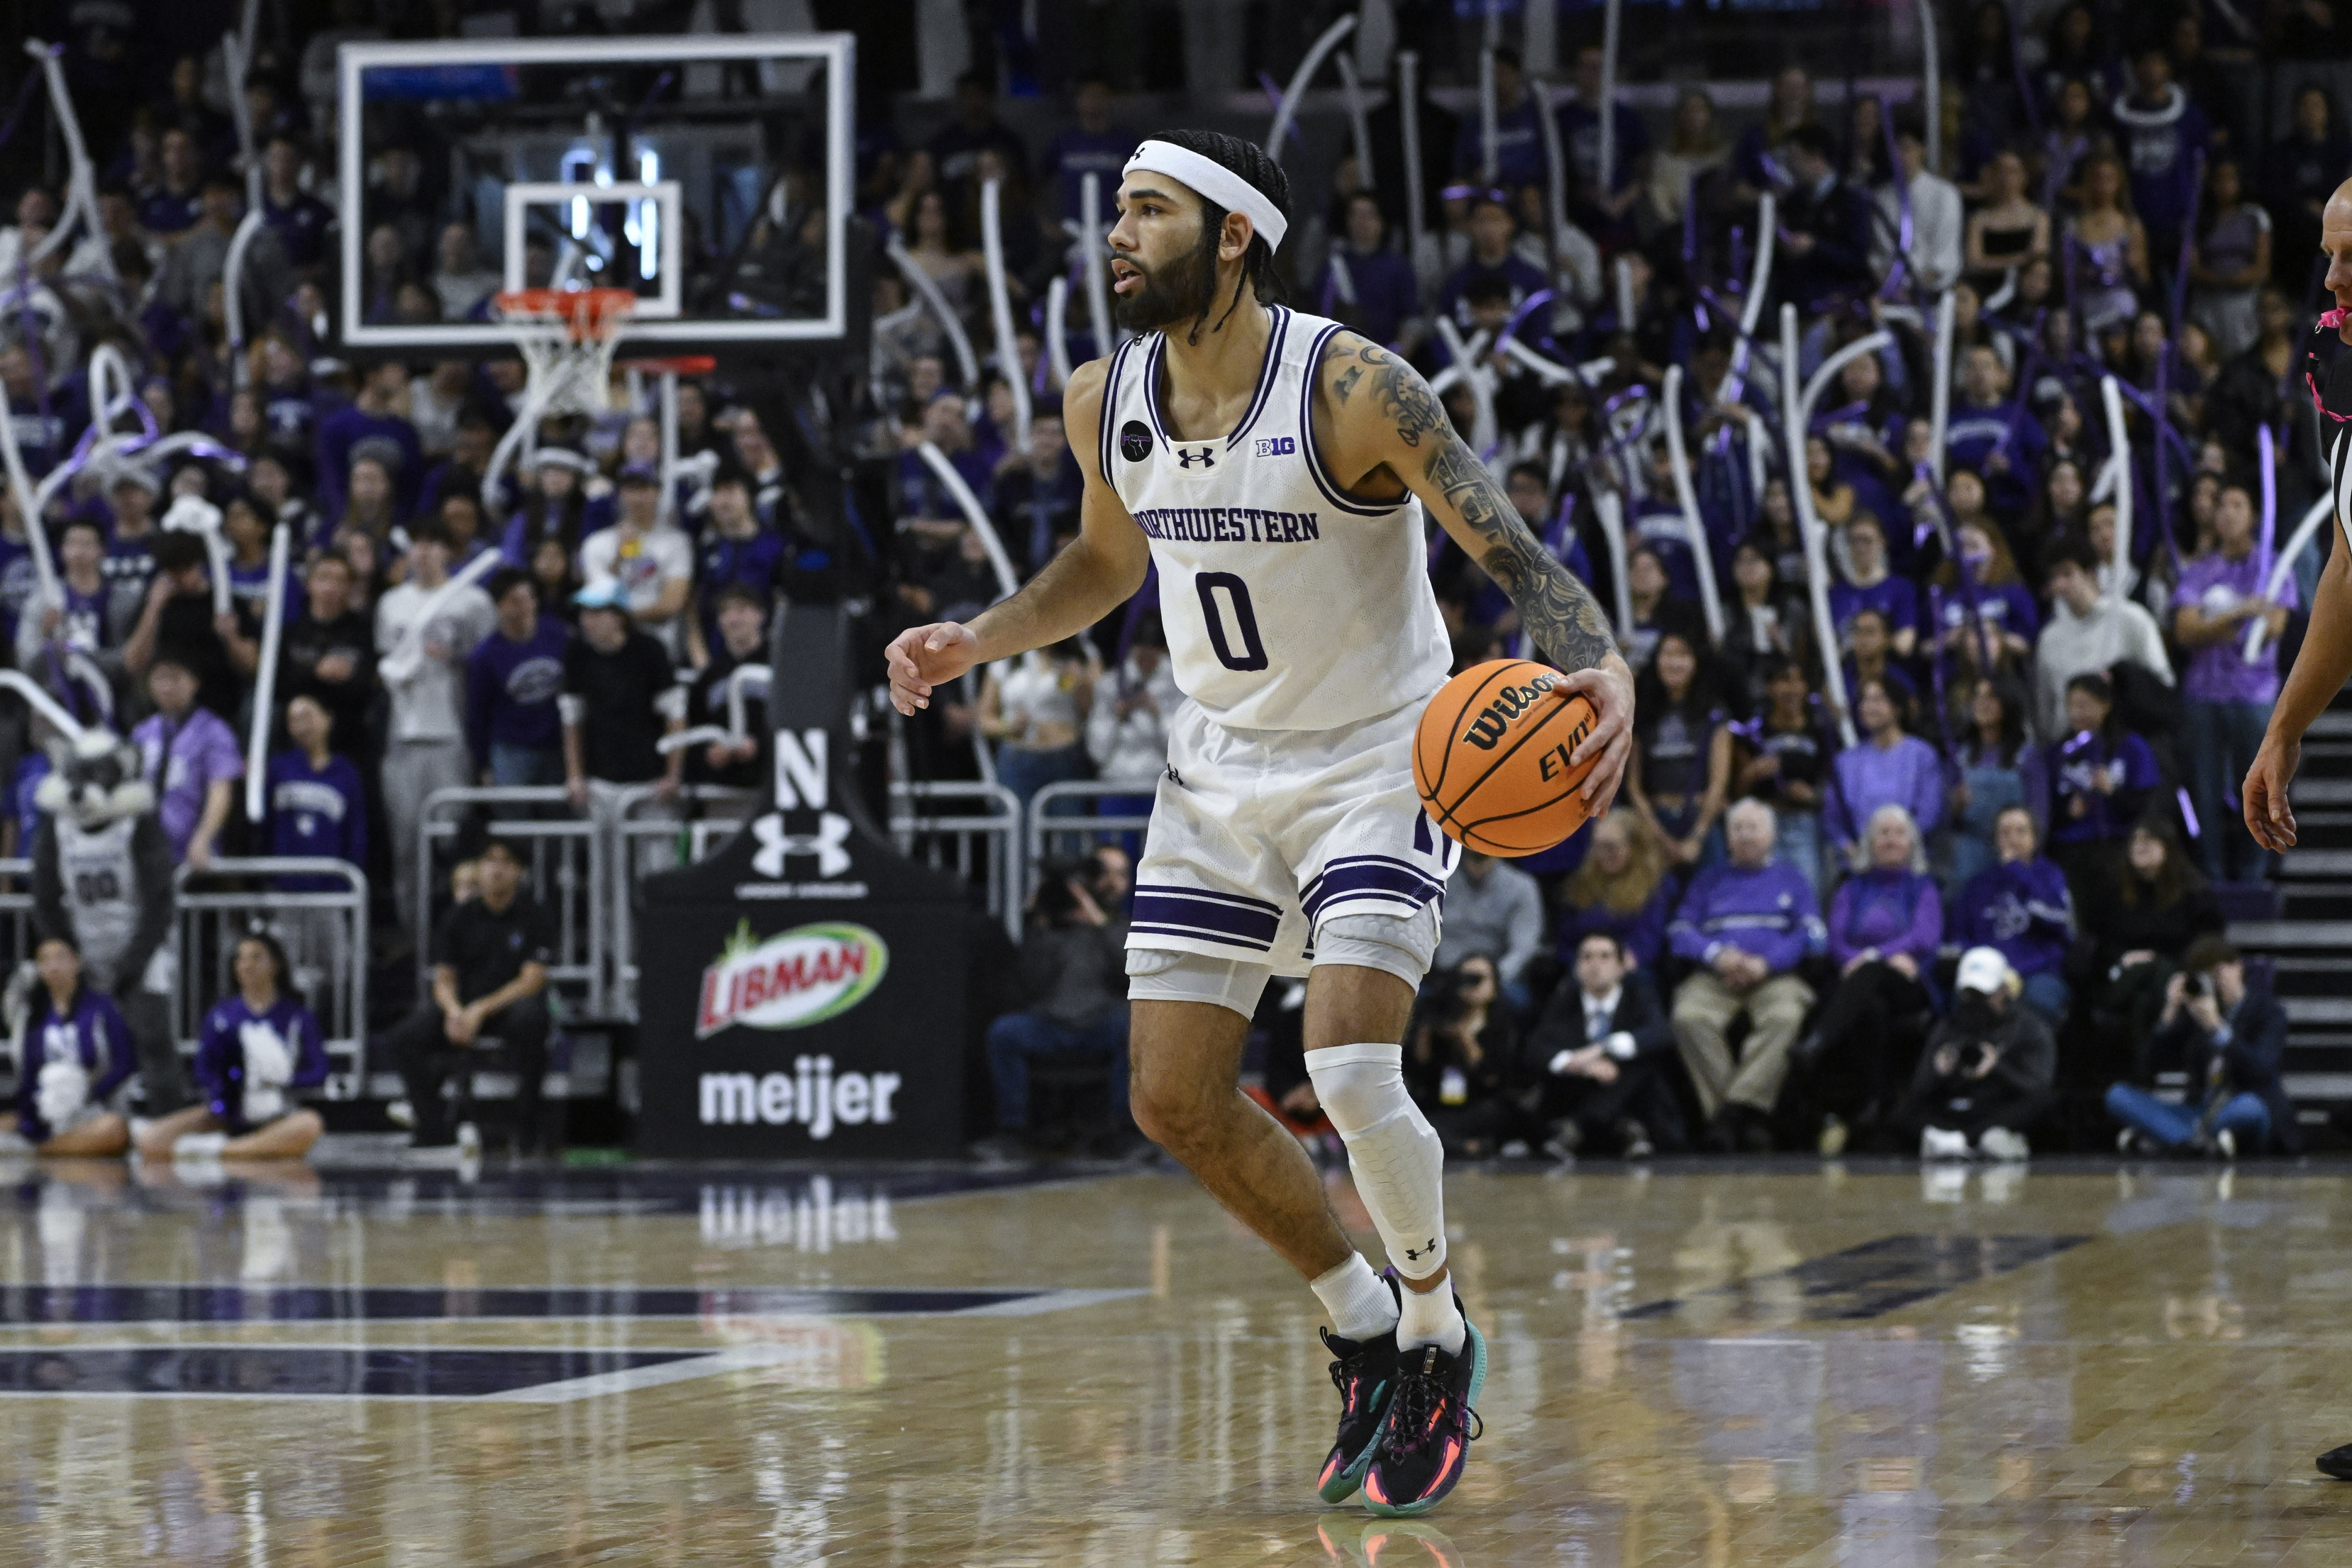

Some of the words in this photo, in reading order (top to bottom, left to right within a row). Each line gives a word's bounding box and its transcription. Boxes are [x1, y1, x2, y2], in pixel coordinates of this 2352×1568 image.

[1195, 572, 1268, 672] 0
[775, 728, 828, 810] N
[698, 943, 867, 1035] LIBMAN
[699, 1054, 901, 1138] meijer
